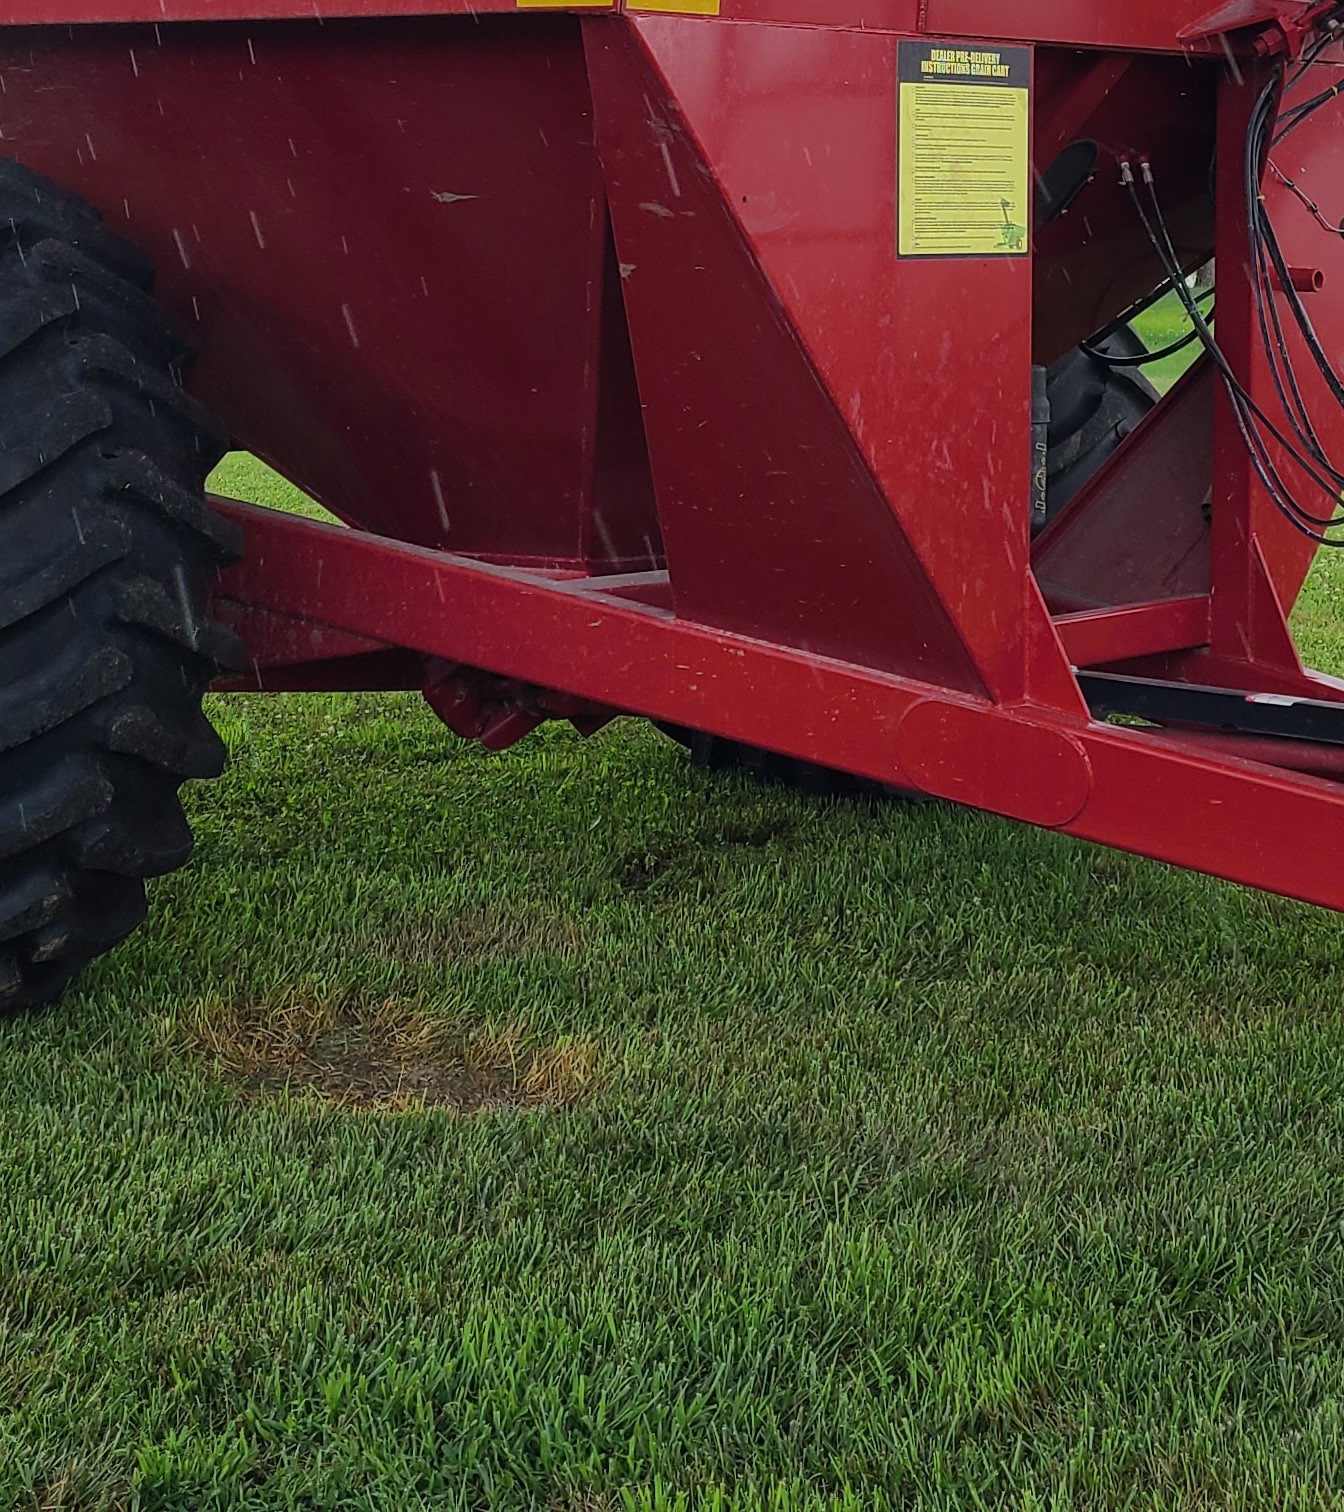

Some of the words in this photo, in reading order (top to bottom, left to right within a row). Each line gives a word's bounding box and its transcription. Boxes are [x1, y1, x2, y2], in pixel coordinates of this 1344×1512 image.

[931, 49, 955, 62] DEALER
[956, 51, 1000, 64] PRE-DELIVERY
[921, 61, 970, 74] INSTRUCTIONS
[992, 65, 1009, 77] CART
